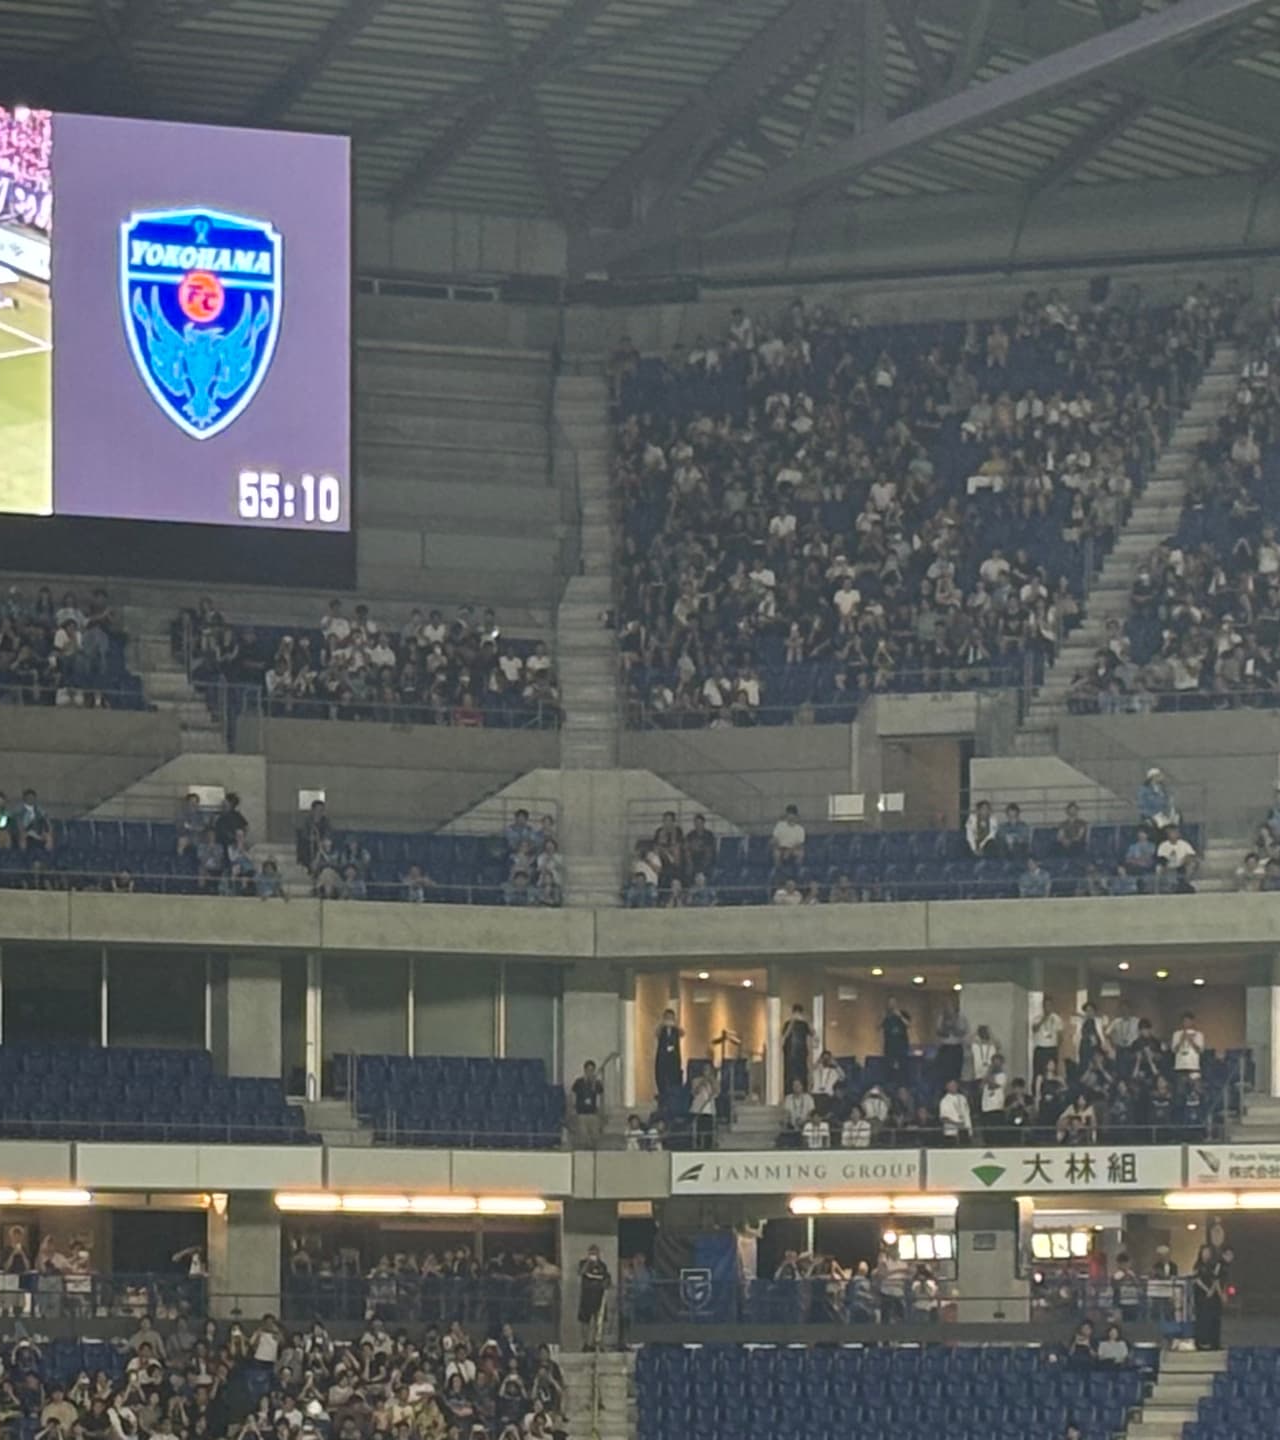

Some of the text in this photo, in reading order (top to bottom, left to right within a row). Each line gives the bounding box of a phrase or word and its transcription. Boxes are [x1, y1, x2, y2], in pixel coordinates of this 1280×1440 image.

[130, 240, 271, 275] YOKOHAMA
[186, 284, 218, 312] FC
[238, 472, 340, 523] 55:10
[713, 1163, 917, 1181] JAMMING GROUP
[1022, 1150, 1138, 1186] 大林組
